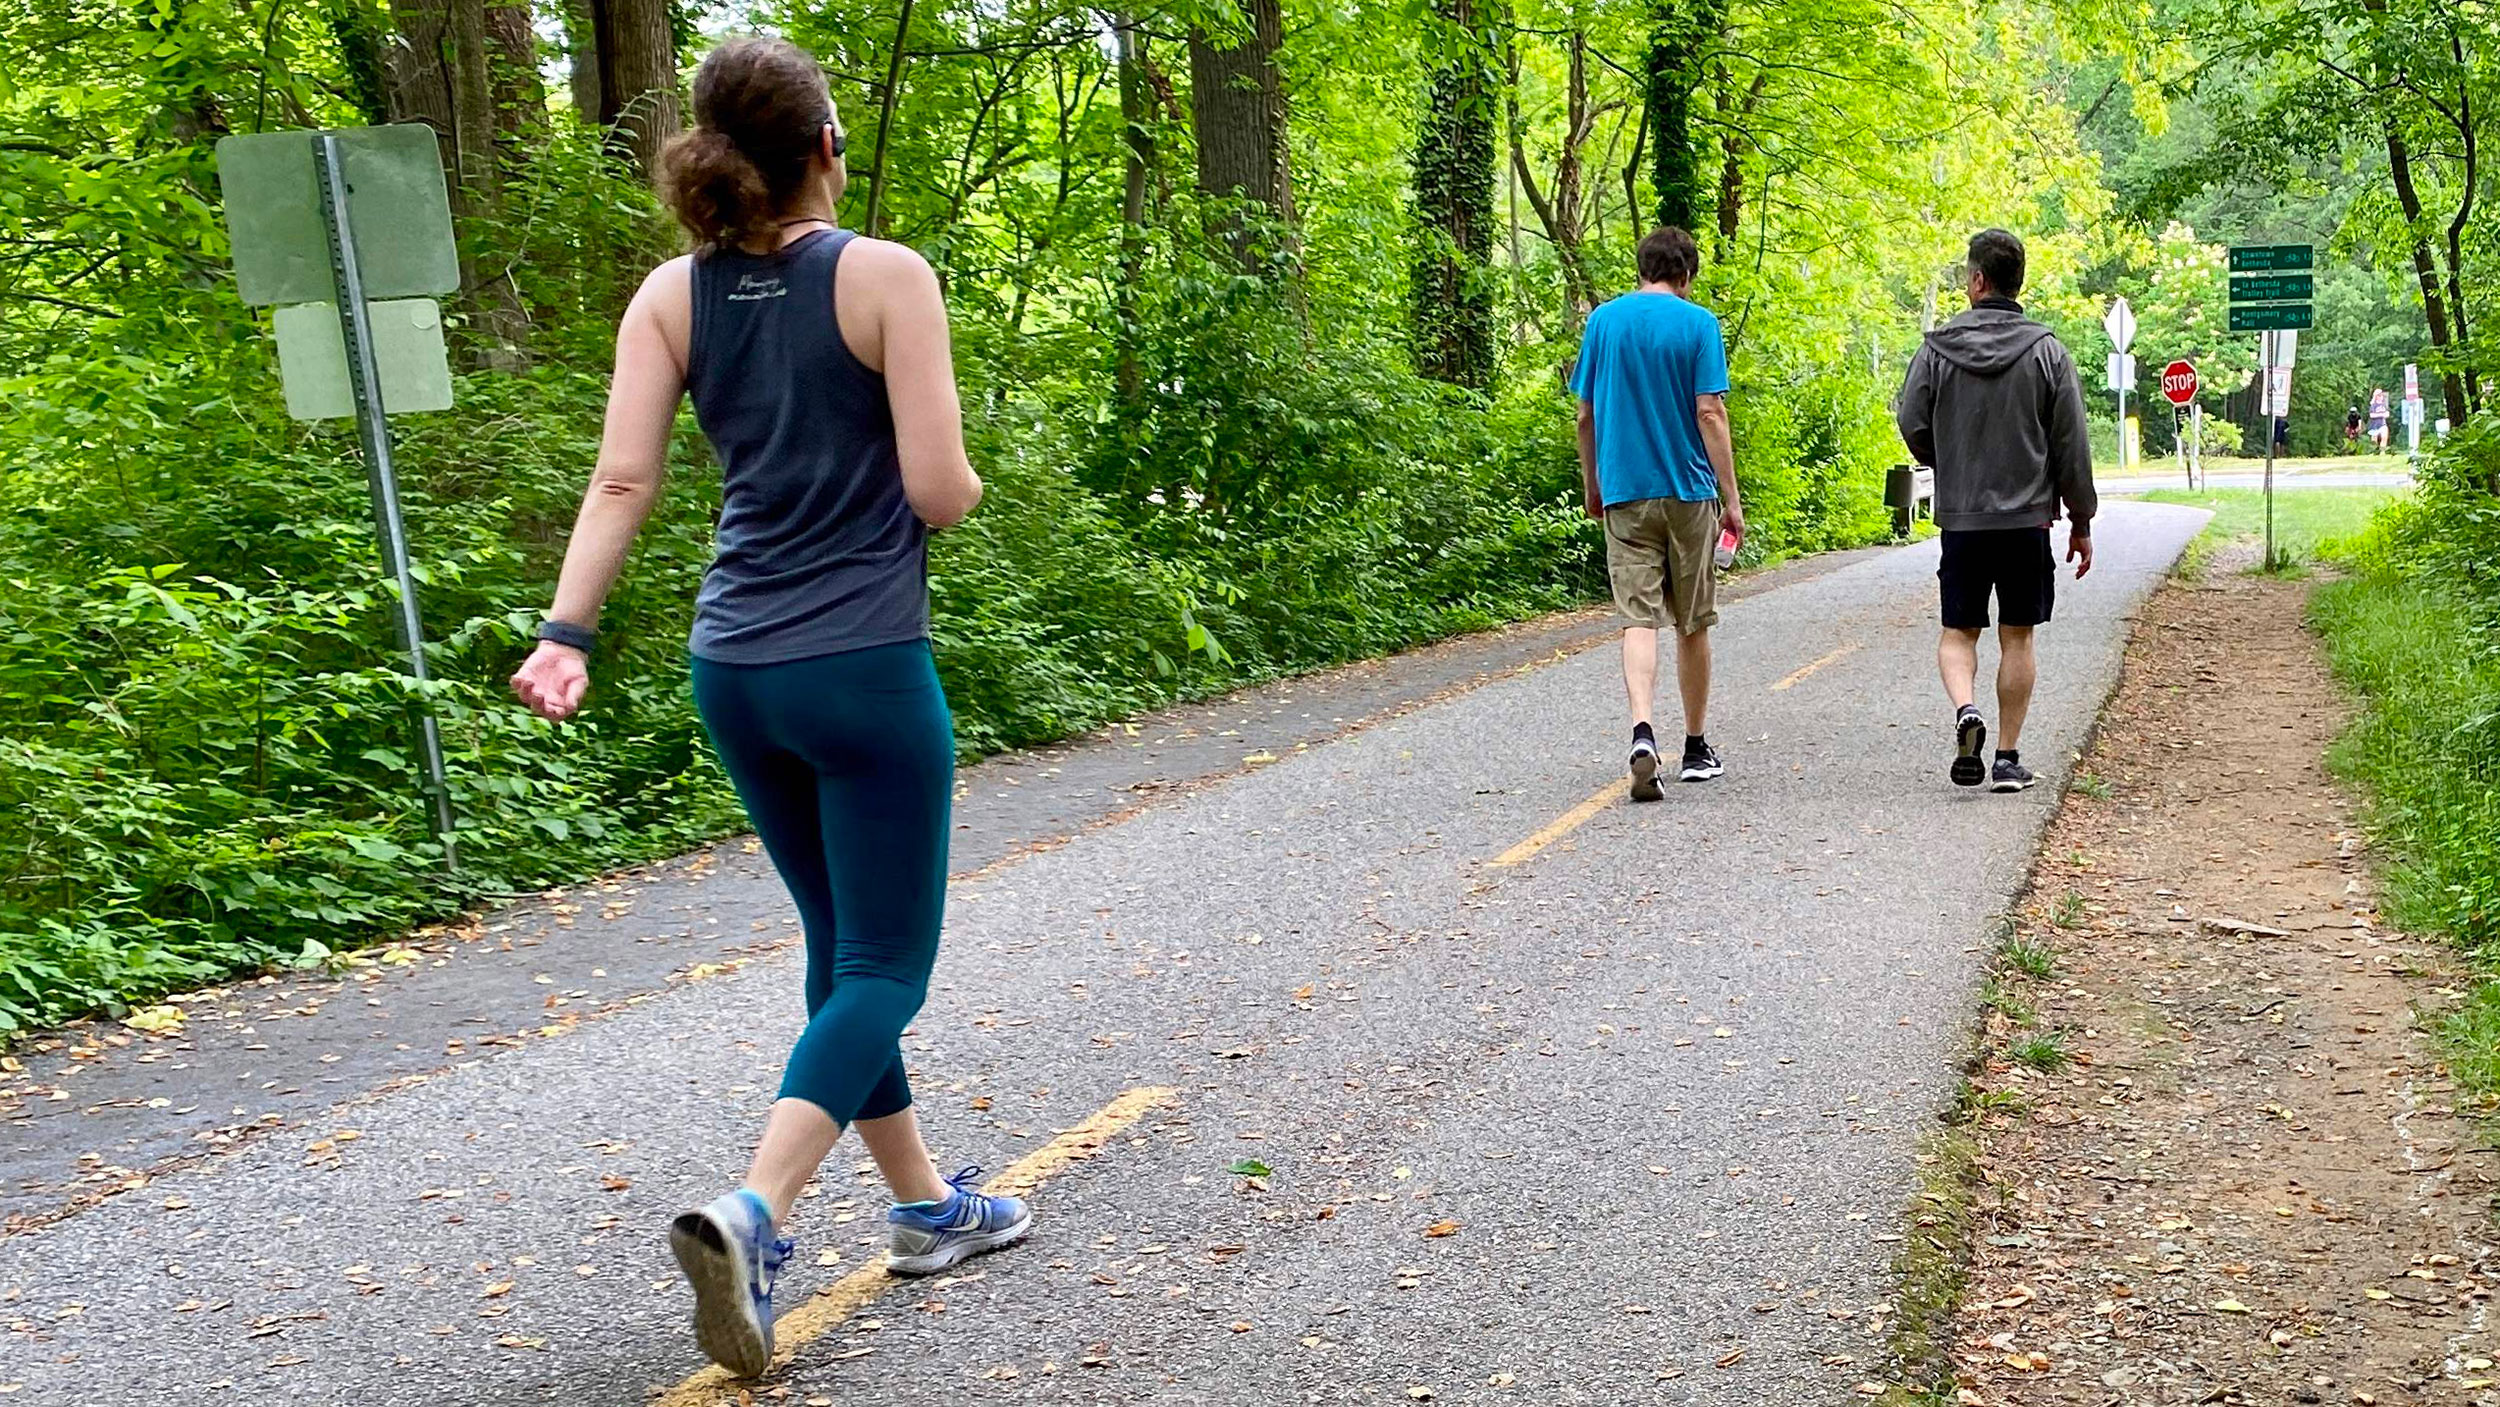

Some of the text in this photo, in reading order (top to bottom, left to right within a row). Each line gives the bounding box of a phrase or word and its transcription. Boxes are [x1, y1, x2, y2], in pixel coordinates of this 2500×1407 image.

[2241, 251, 2275, 259] Downtown
[2241, 260, 2271, 268] Bethesda
[2242, 280, 2280, 289] To Bethesda
[2242, 289, 2280, 298] Trolley Trail
[2241, 311, 2280, 319] Montgomery
[2241, 319, 2255, 327] Mall
[2164, 373, 2195, 393] STOP
